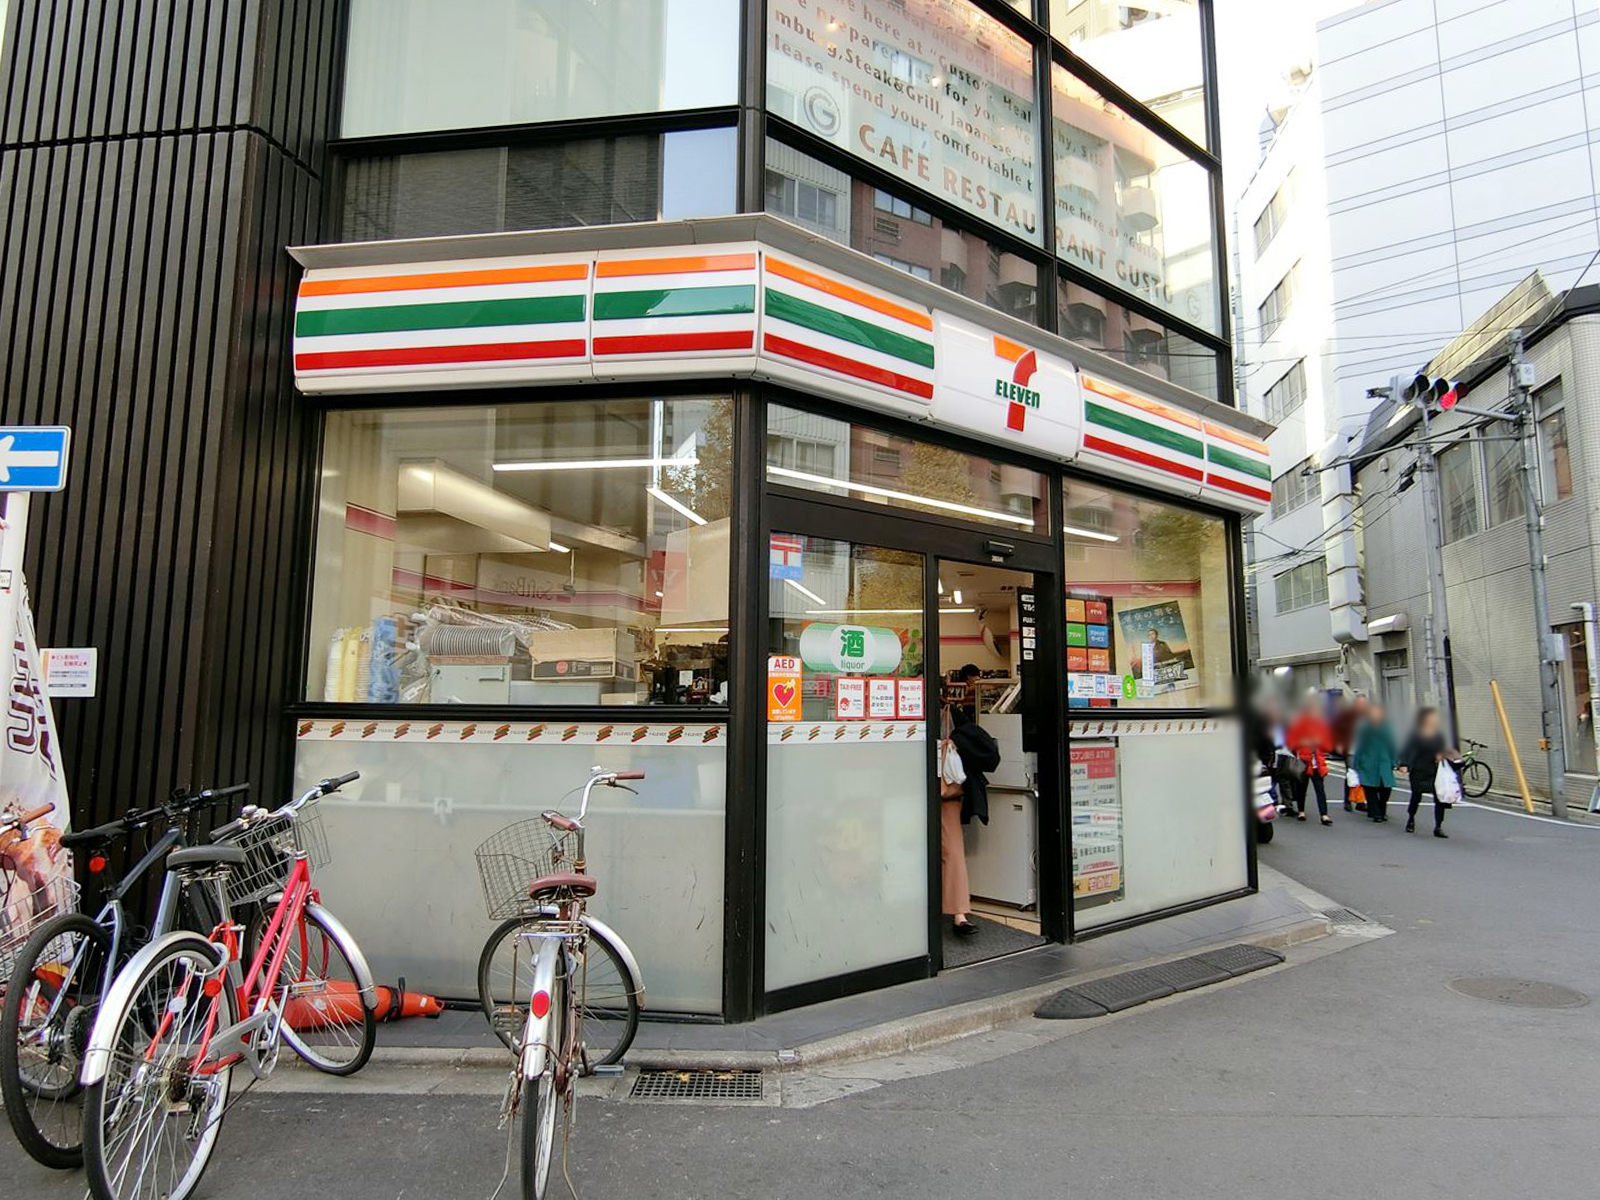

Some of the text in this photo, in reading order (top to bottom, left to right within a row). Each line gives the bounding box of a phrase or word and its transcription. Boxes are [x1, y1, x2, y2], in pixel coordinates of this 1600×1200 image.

[863, 4, 901, 40] here
[907, 39, 923, 55] at
[945, 83, 968, 107] for
[890, 104, 928, 132] your
[934, 129, 1022, 185] comfortable
[993, 335, 1037, 432] 7
[840, 629, 865, 657] 酒
[774, 658, 795, 669] AED
[840, 659, 865, 671] liquor
